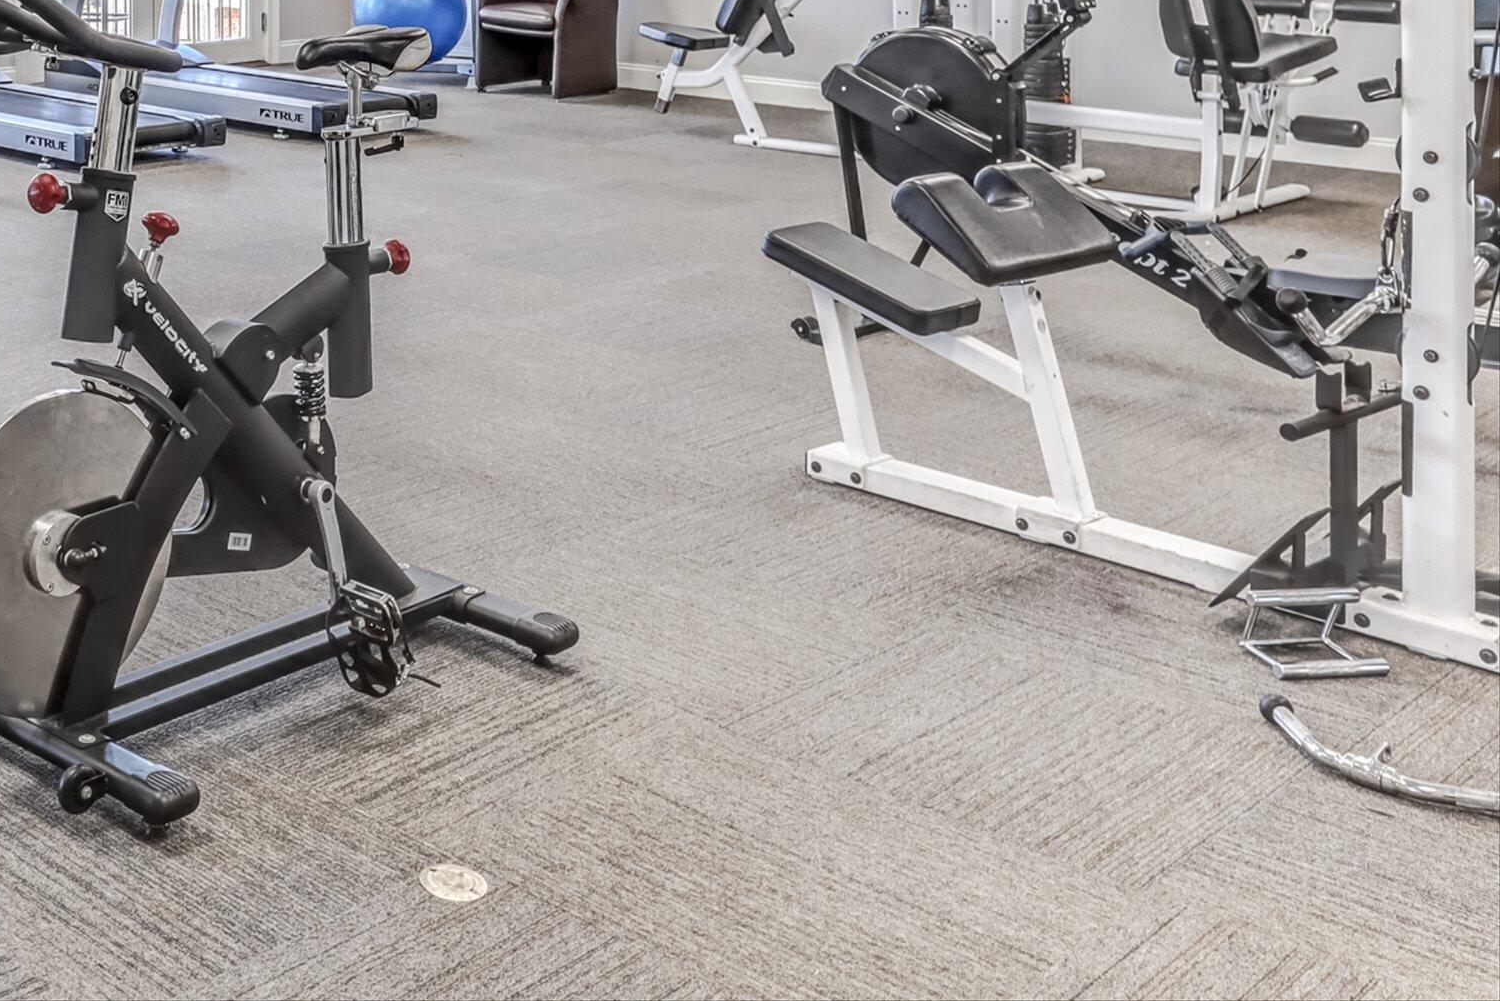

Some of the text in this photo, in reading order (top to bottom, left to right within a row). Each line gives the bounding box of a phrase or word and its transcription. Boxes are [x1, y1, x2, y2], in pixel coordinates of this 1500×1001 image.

[272, 109, 305, 124] TRUE
[35, 136, 68, 152] TRUE
[1170, 268, 1192, 289] 2
